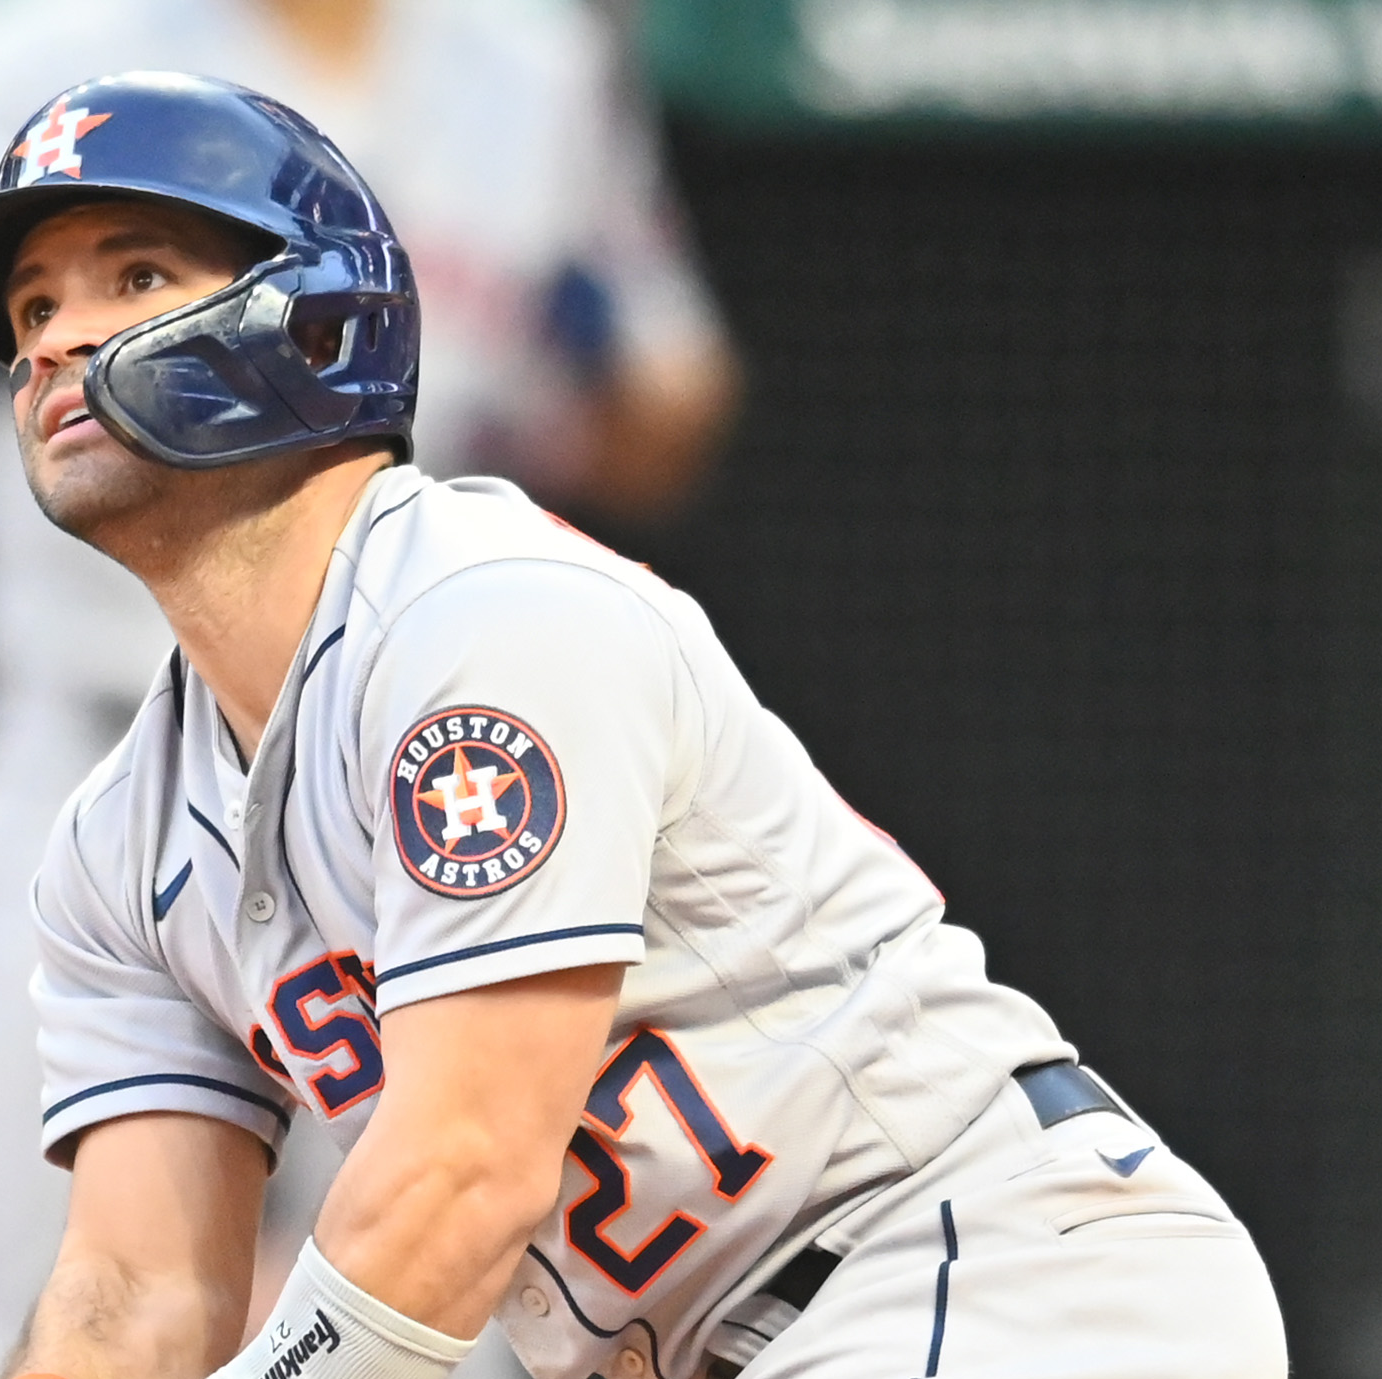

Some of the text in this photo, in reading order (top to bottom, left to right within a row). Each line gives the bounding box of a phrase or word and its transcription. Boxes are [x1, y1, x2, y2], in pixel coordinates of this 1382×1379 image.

[397, 716, 534, 784] HOUSTON
[431, 765, 508, 841] H
[419, 830, 543, 887] ASTROS
[565, 1025, 774, 1299] 27
